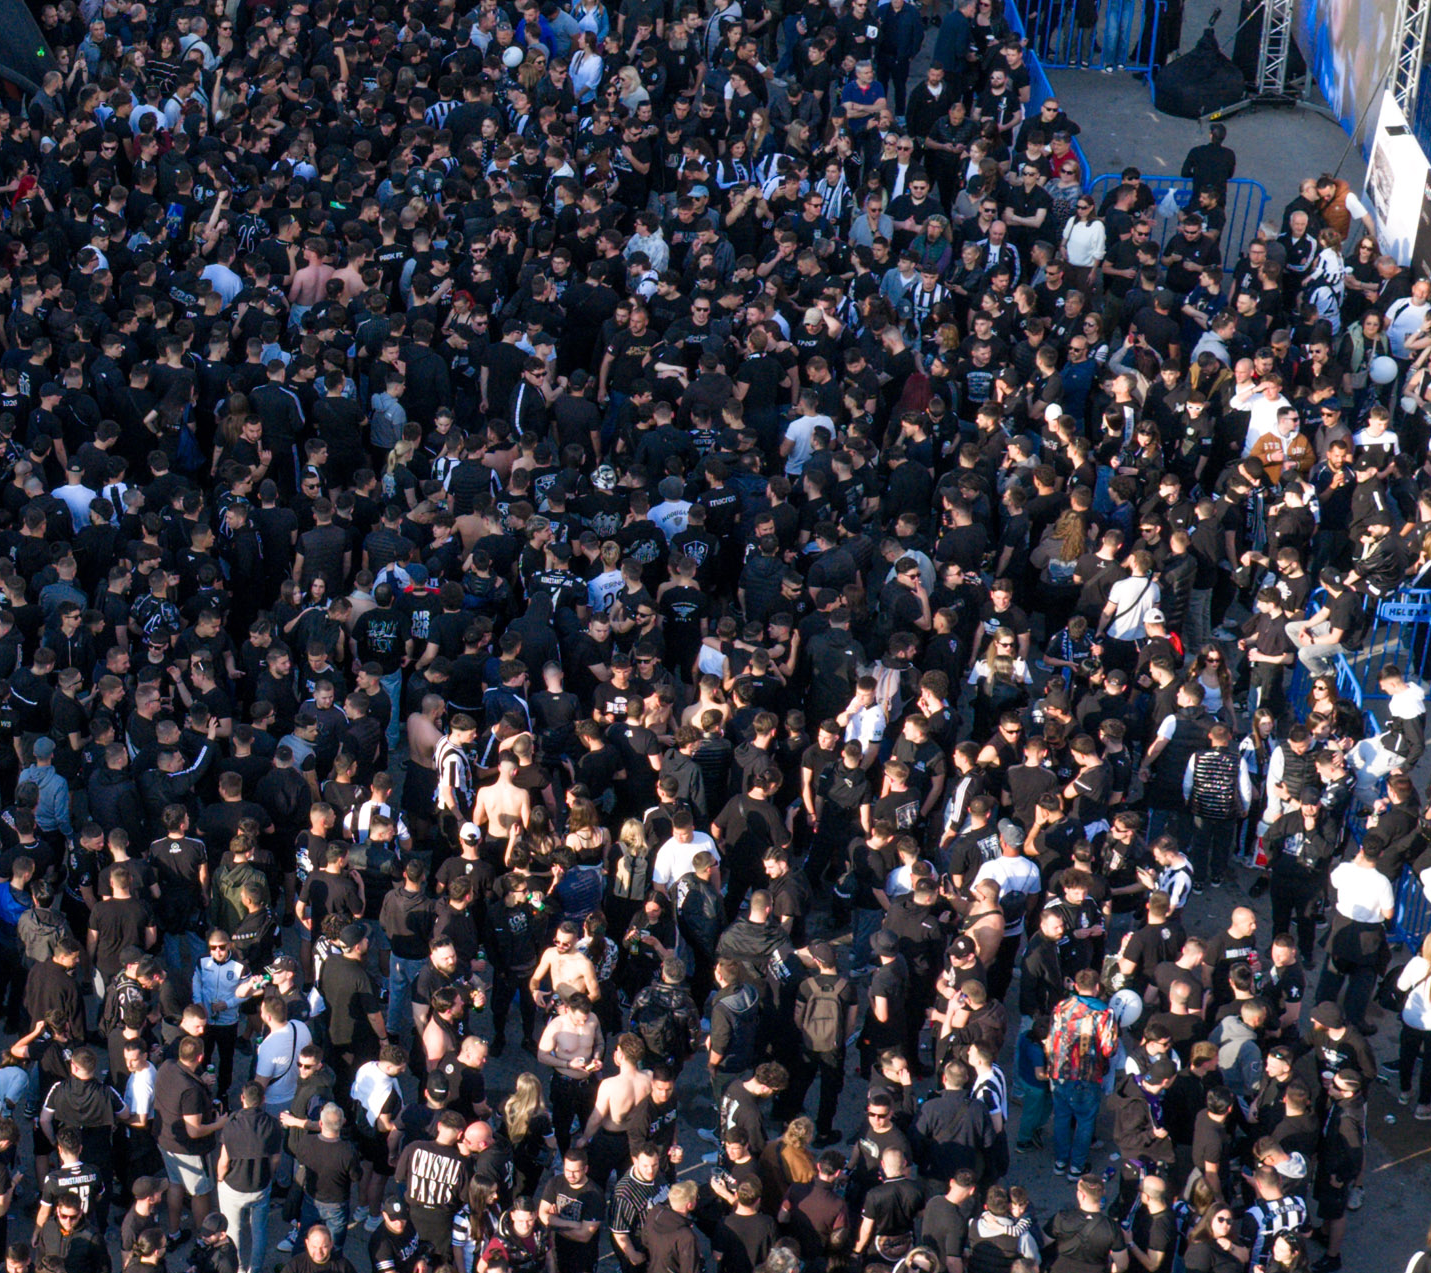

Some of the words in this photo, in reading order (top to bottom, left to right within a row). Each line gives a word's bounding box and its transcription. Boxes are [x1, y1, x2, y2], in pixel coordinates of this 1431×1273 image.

[412, 610, 430, 620] AIR
[410, 1147, 461, 1181] CRYSTAL
[408, 1174, 455, 1206] PARIS
